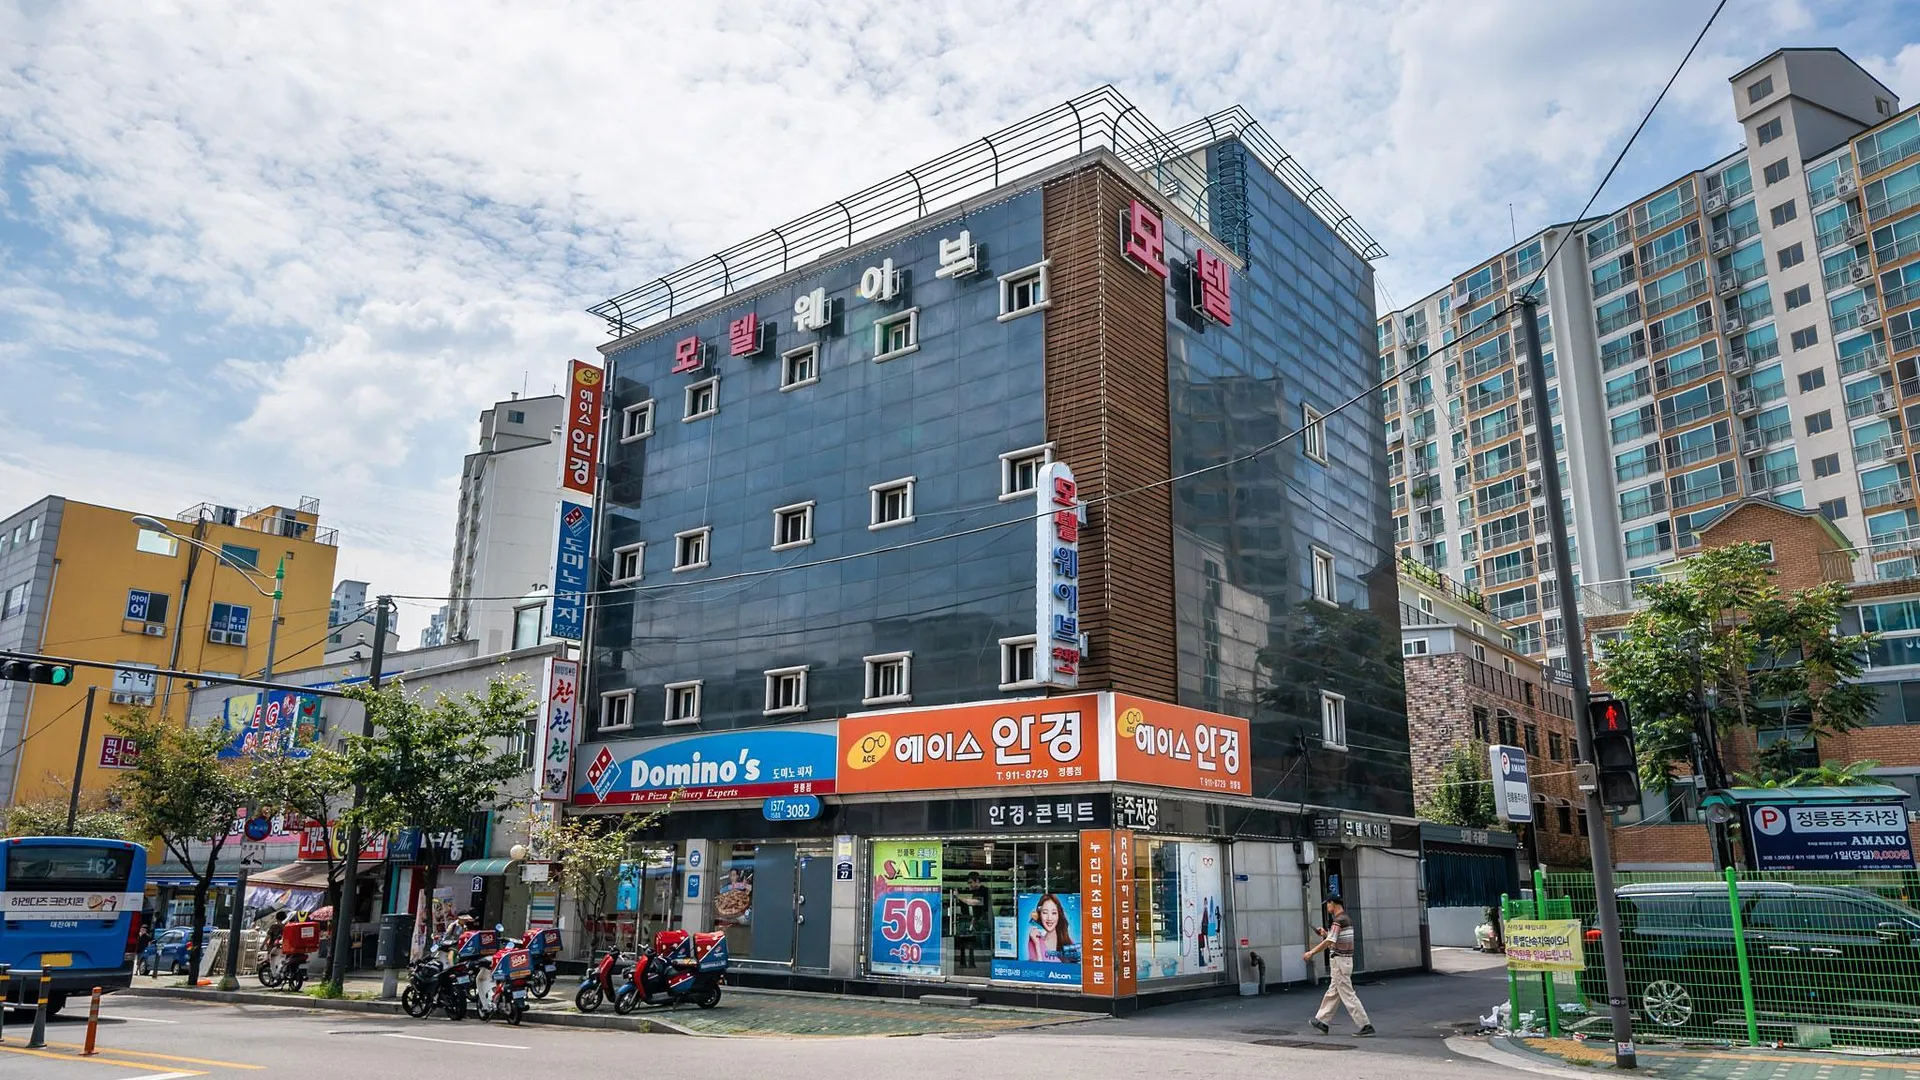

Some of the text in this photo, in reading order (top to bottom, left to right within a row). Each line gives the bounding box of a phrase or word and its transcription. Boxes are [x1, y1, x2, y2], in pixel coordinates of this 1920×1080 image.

[1127, 199, 1231, 327] 모텔
[672, 230, 976, 375] 모텔 웨이브
[569, 389, 595, 485] 에이스 안경
[1053, 476, 1078, 643] 모텔 웨이브
[131, 594, 147, 603] 아이
[130, 604, 144, 617] 어
[554, 623, 579, 632] 1577
[119, 670, 152, 687] 수학
[895, 711, 1081, 766] 에이스 안경
[103, 739, 118, 764] 피아노
[1135, 723, 1240, 775] 에이스 안경
[862, 755, 876, 763] ACE
[631, 748, 761, 788] Domino's
[773, 765, 813, 779] 도미노 피자
[1006, 769, 1049, 781] 911-8729
[1058, 767, 1082, 777] 정릉점
[631, 793, 645, 801] The
[648, 791, 667, 800] Pizza
[706, 789, 738, 799] Experts
[771, 800, 785, 812] 1577
[1123, 796, 1158, 826] 주차장
[1762, 810, 1778, 830] P
[1797, 809, 1899, 828] 정릉동주차장
[1851, 835, 1907, 846] AMANO
[841, 871, 849, 879] 27
[884, 859, 938, 880] SALE
[1048, 970, 1072, 980] Alcon
